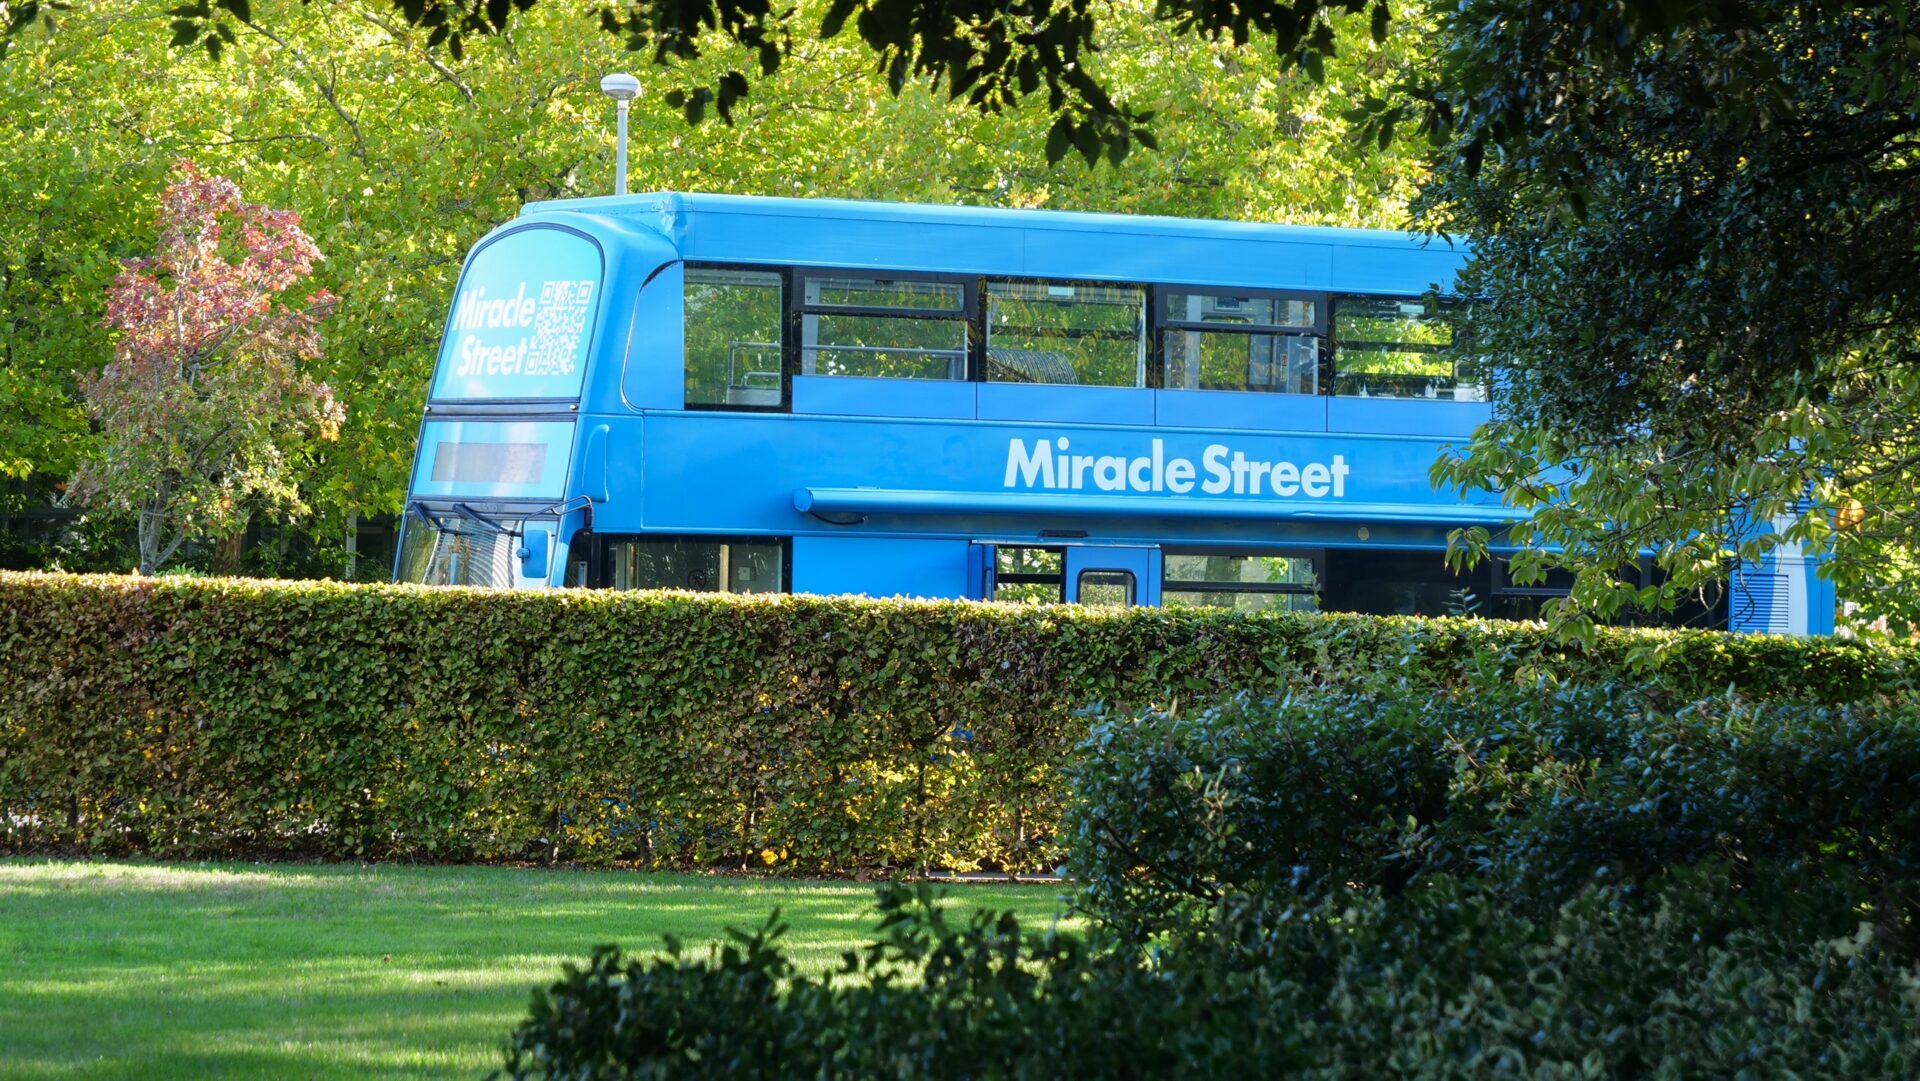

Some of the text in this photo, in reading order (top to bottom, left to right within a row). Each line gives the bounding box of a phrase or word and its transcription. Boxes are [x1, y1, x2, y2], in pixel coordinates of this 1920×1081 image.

[453, 282, 536, 331] Miracle
[457, 335, 528, 376] Street
[1003, 437, 1349, 497] Miracle Street
